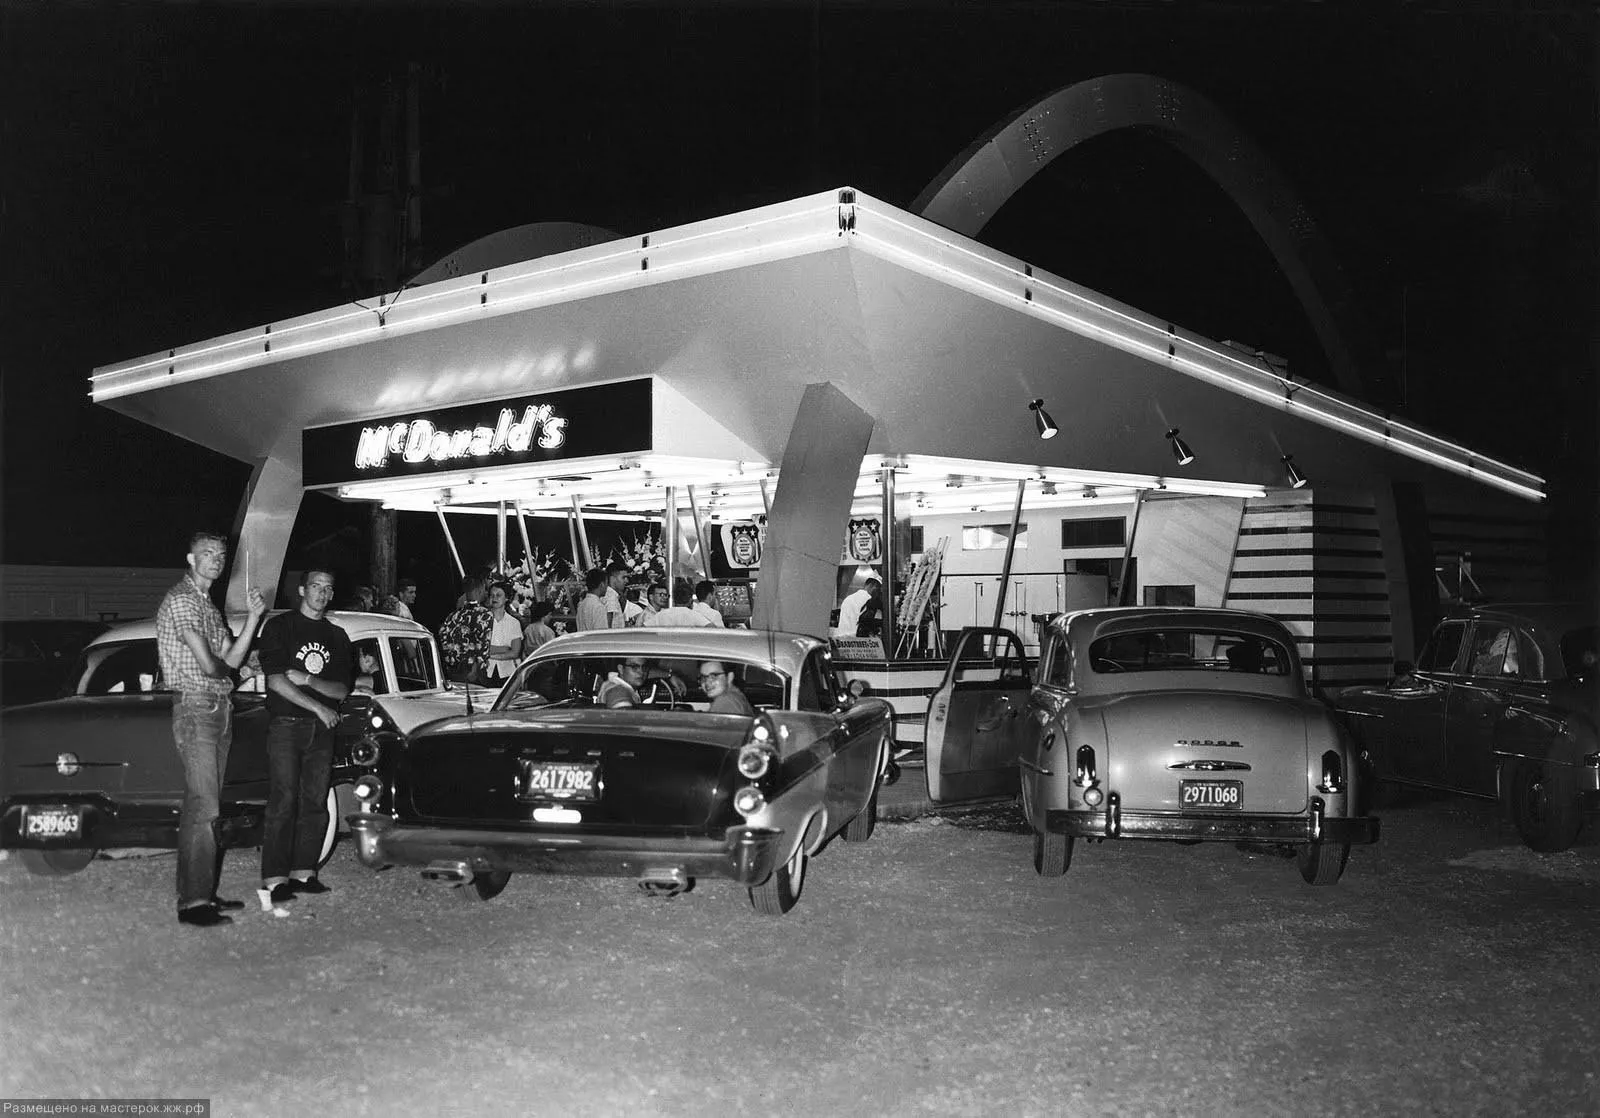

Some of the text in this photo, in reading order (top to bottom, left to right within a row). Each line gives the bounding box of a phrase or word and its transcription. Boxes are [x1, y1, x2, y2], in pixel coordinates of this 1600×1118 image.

[355, 404, 568, 470] McDonald's
[530, 769, 593, 790] 2617982
[1184, 787, 1238, 803] 2971068
[29, 815, 79, 833] 2589663
